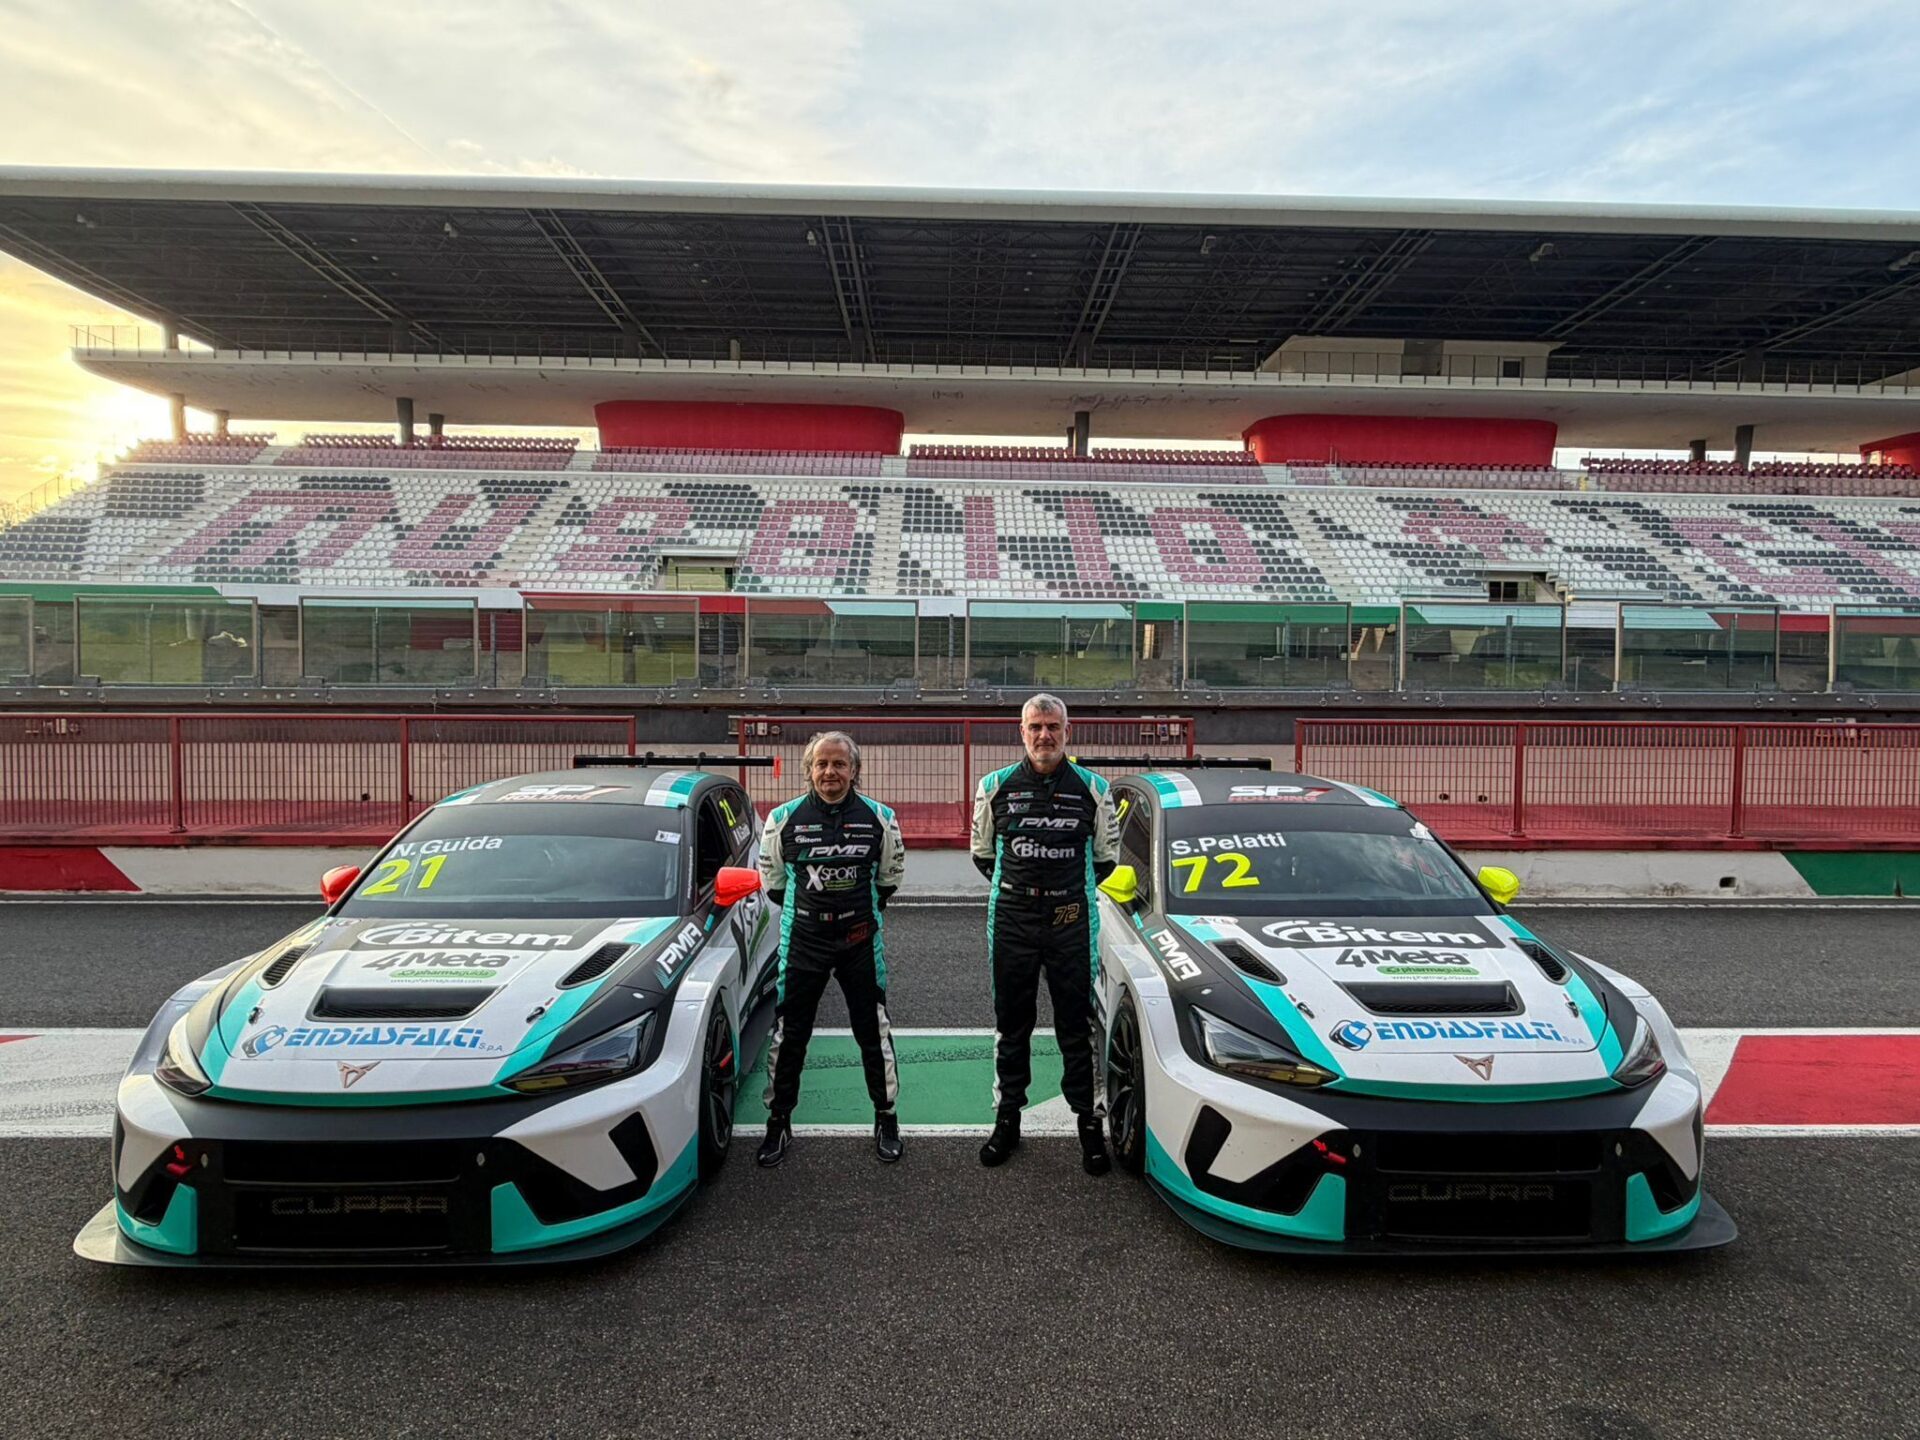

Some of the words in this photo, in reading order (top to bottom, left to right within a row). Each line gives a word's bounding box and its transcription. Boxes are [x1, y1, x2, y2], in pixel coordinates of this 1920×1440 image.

[390, 836, 503, 859] N.Guida
[1021, 842, 1075, 859] Bitem
[1171, 833, 1286, 856] S.Pelatti
[361, 854, 447, 896] 21
[1171, 852, 1261, 893] 72
[1052, 903, 1080, 925] 72
[389, 926, 573, 946] Bitem
[1306, 922, 1484, 945] Bitem
[362, 950, 511, 970] 4Meta
[1335, 948, 1471, 968] 4Meta
[1388, 1183, 1555, 1201] CUPRA
[271, 1194, 448, 1215] CUPRA
